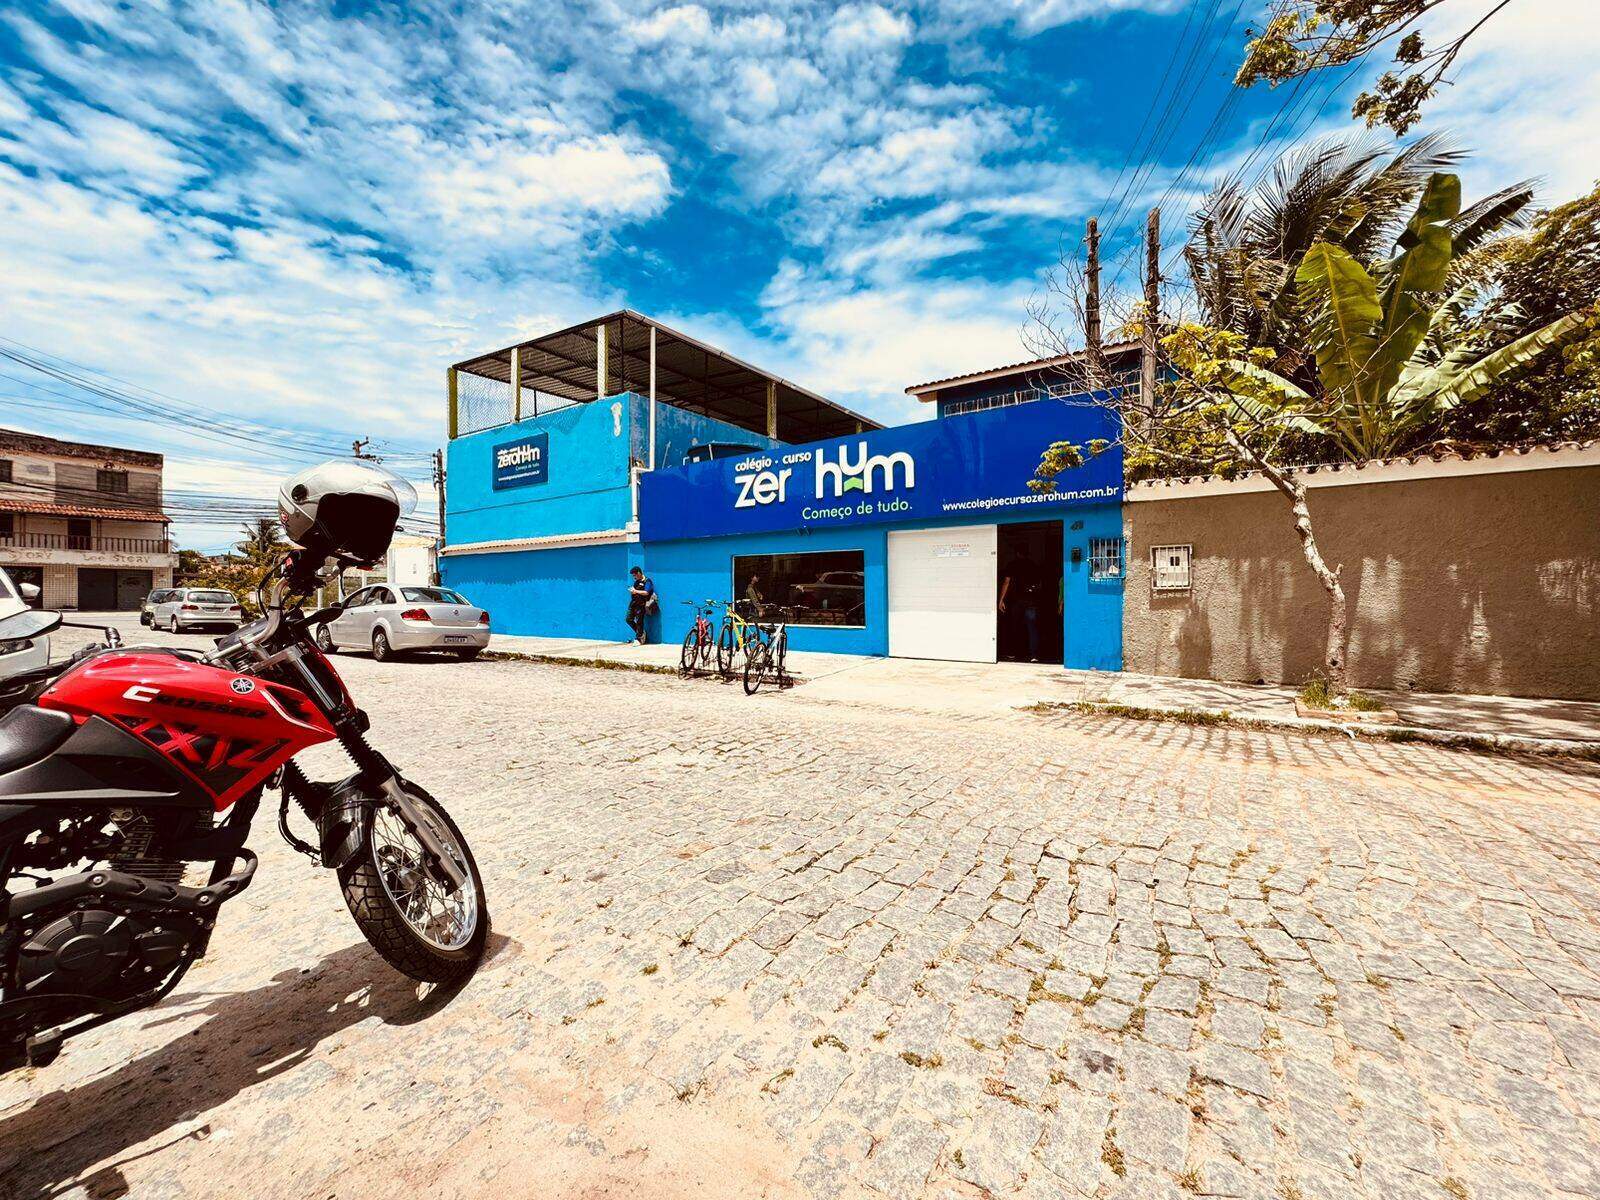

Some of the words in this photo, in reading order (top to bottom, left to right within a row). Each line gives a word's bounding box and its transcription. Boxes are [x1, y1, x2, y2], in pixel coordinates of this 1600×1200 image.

[735, 456, 772, 472] colégio
[782, 452, 812, 464] curso
[735, 468, 792, 508] zer
[942, 486, 1120, 511] www.colegioecursozerohum.com.br
[802, 506, 852, 520] Começo
[856, 501, 873, 514] de
[877, 497, 913, 512] tudo.
